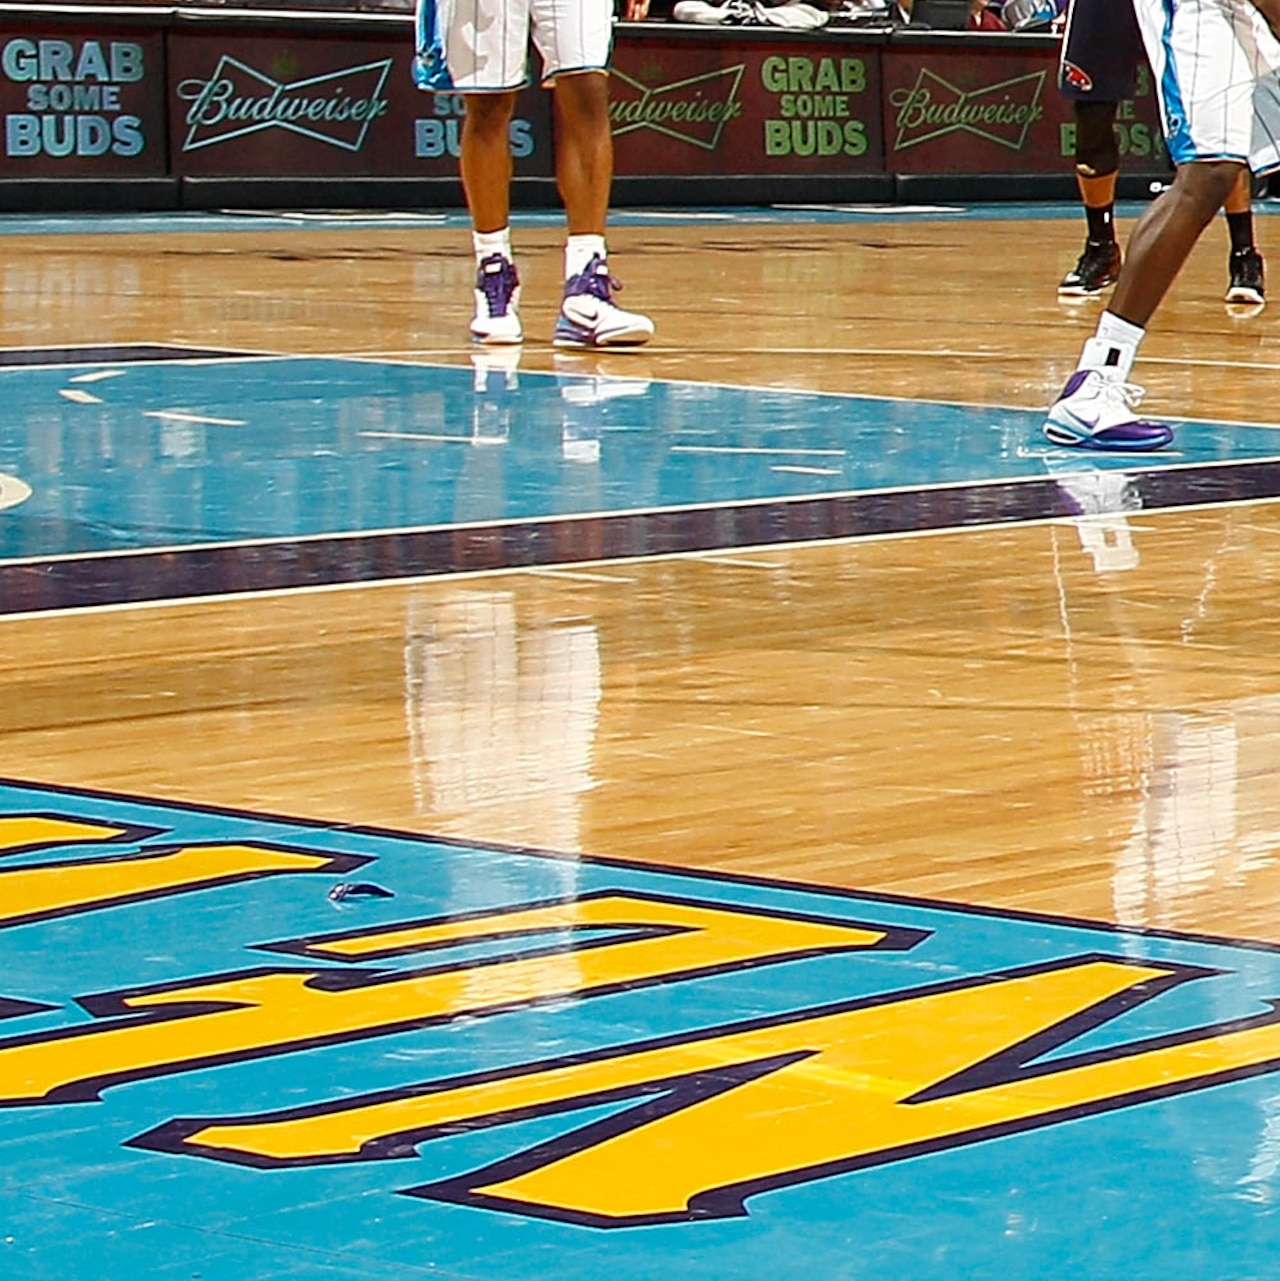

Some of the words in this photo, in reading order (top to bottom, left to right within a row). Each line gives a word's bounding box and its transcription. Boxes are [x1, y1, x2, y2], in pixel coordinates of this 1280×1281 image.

[2, 38, 145, 83] GRAB
[761, 56, 866, 93] GRAB
[27, 84, 121, 112] SOME
[176, 78, 388, 126] Budweiser
[607, 92, 742, 123] udweiser
[780, 94, 850, 118] SOME
[889, 88, 1045, 129] Budweiser
[6, 114, 145, 158] BUDS
[414, 119, 536, 158] BUS
[765, 122, 868, 157] BUDS
